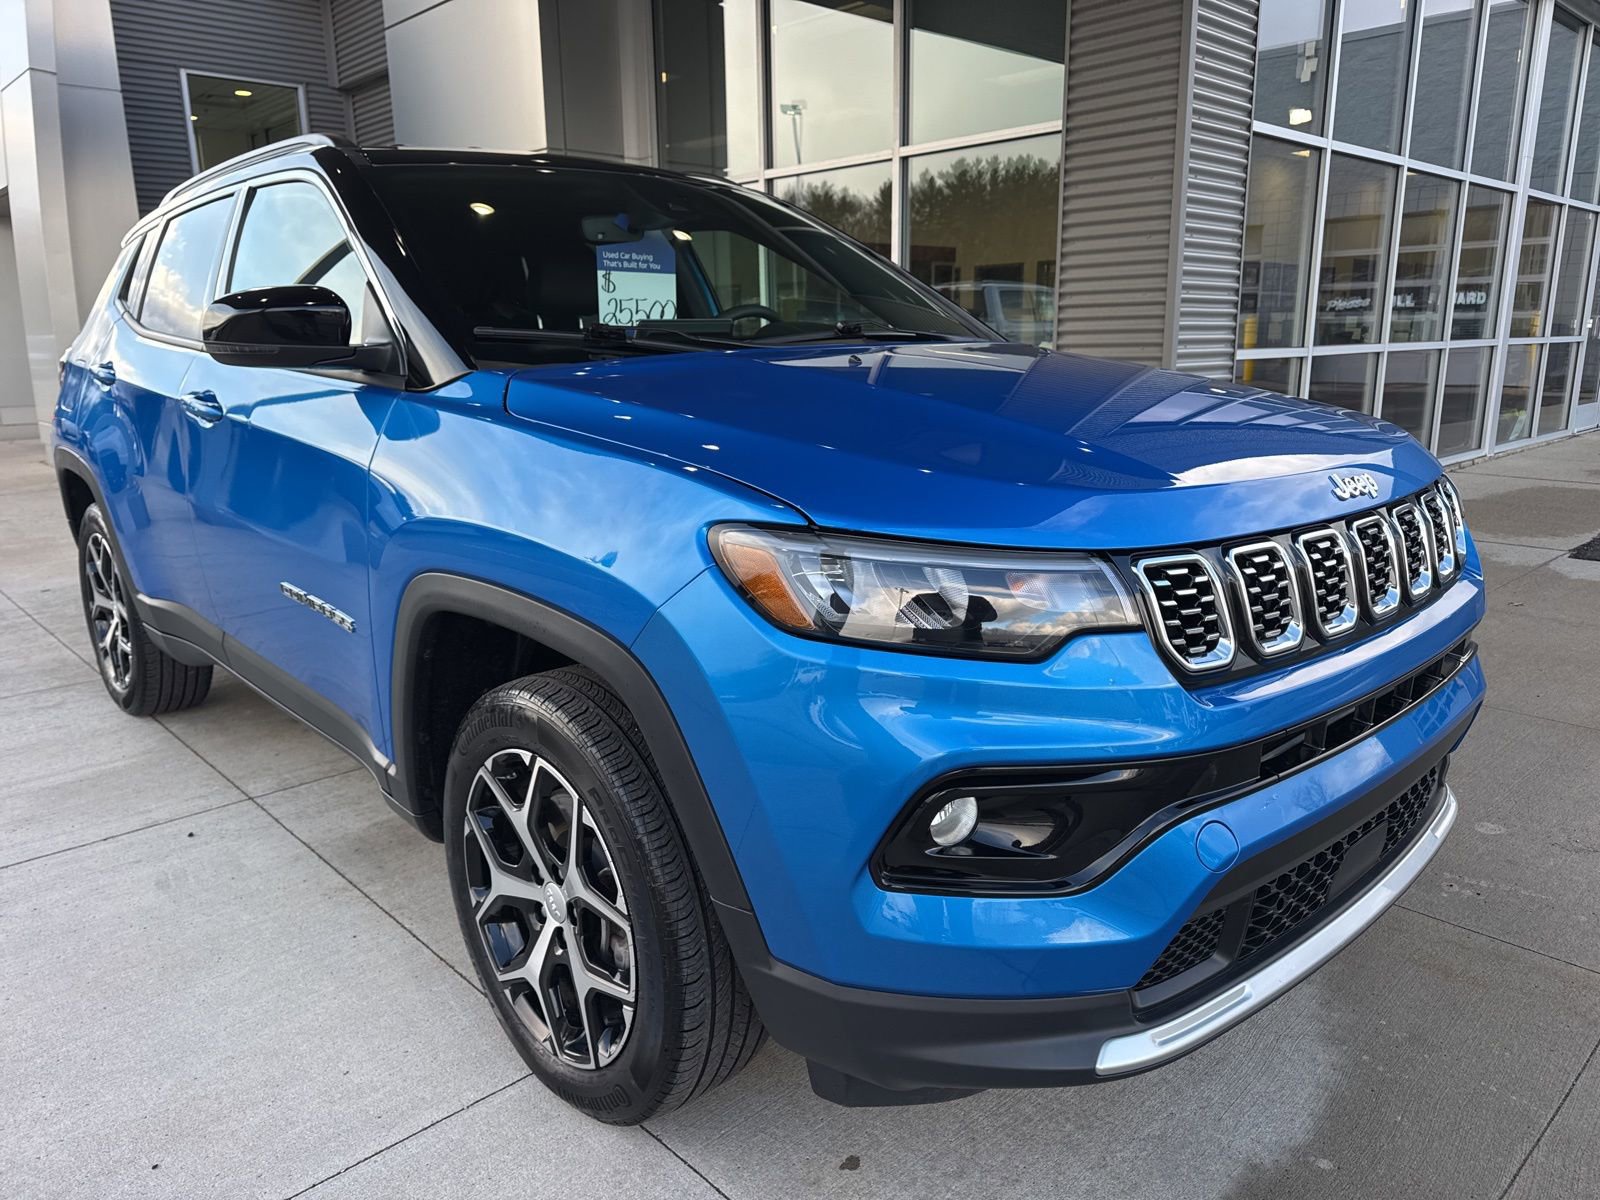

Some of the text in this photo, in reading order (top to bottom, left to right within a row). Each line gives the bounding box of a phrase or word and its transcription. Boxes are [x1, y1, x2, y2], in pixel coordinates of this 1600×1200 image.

[602, 251, 654, 262] Used Car Buying
[603, 259, 622, 268] That's
[623, 260, 638, 269] Built
[638, 261, 648, 269] for
[601, 270, 616, 293] $
[1328, 473, 1379, 501] Jeep
